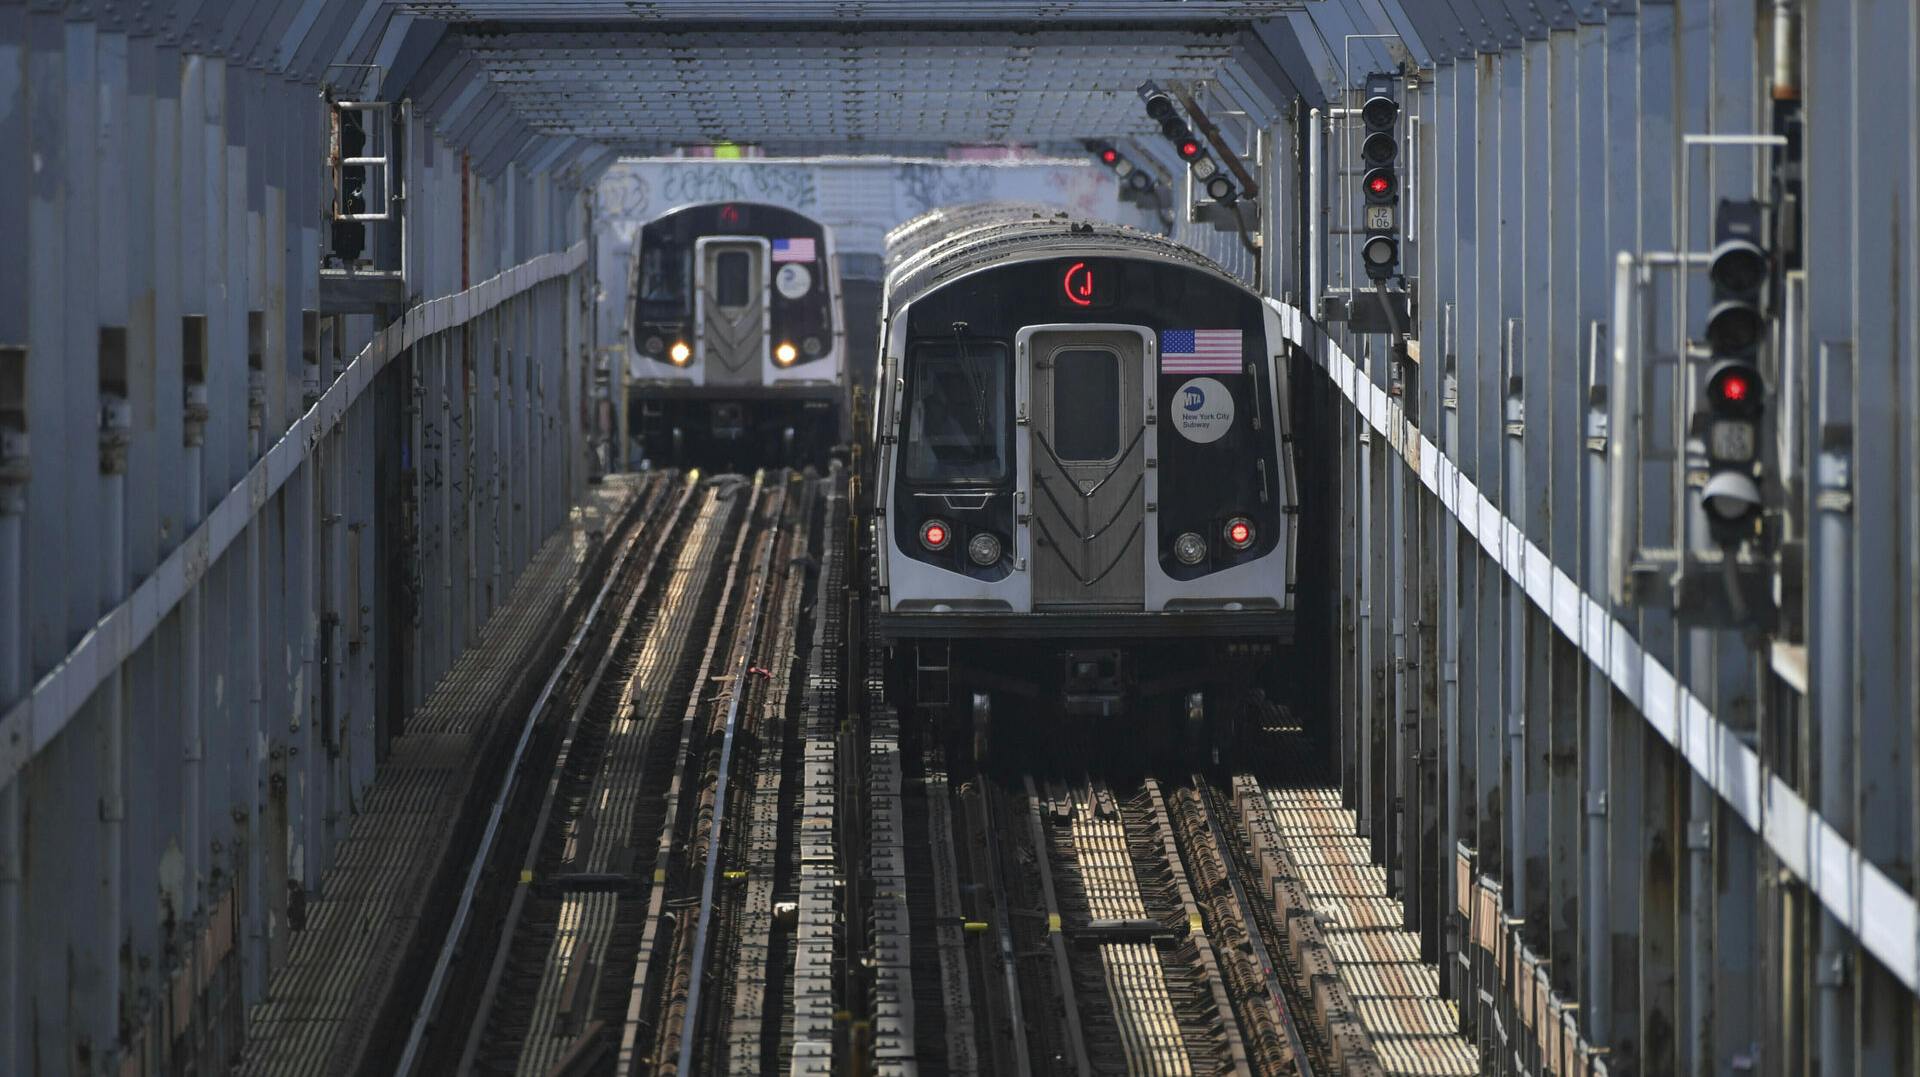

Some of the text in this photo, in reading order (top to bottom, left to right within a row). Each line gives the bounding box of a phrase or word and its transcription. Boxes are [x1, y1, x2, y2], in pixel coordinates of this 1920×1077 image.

[1374, 208, 1388, 218] J2
[1371, 218, 1390, 228] 106
[1184, 392, 1201, 406] MTA
[1216, 413, 1230, 421] City
[1183, 421, 1210, 429] Subway
